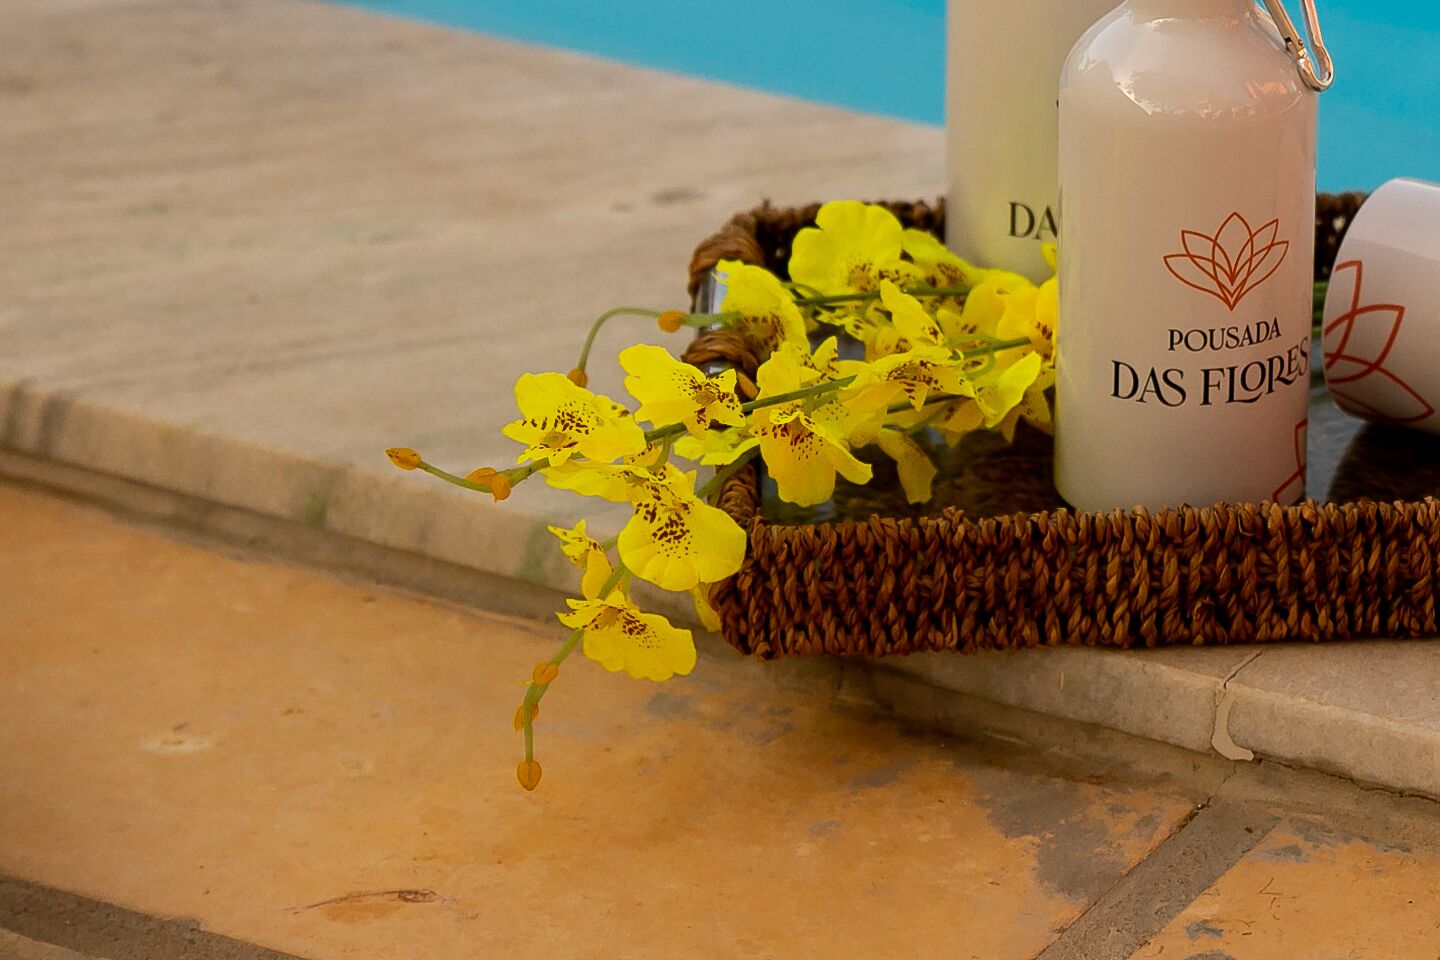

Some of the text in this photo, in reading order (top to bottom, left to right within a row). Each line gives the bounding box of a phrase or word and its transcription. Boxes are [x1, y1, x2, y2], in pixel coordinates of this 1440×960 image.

[1008, 201, 1058, 241] DA
[1167, 316, 1282, 352] POUSADA
[1110, 336, 1309, 408] DAS FLORES
